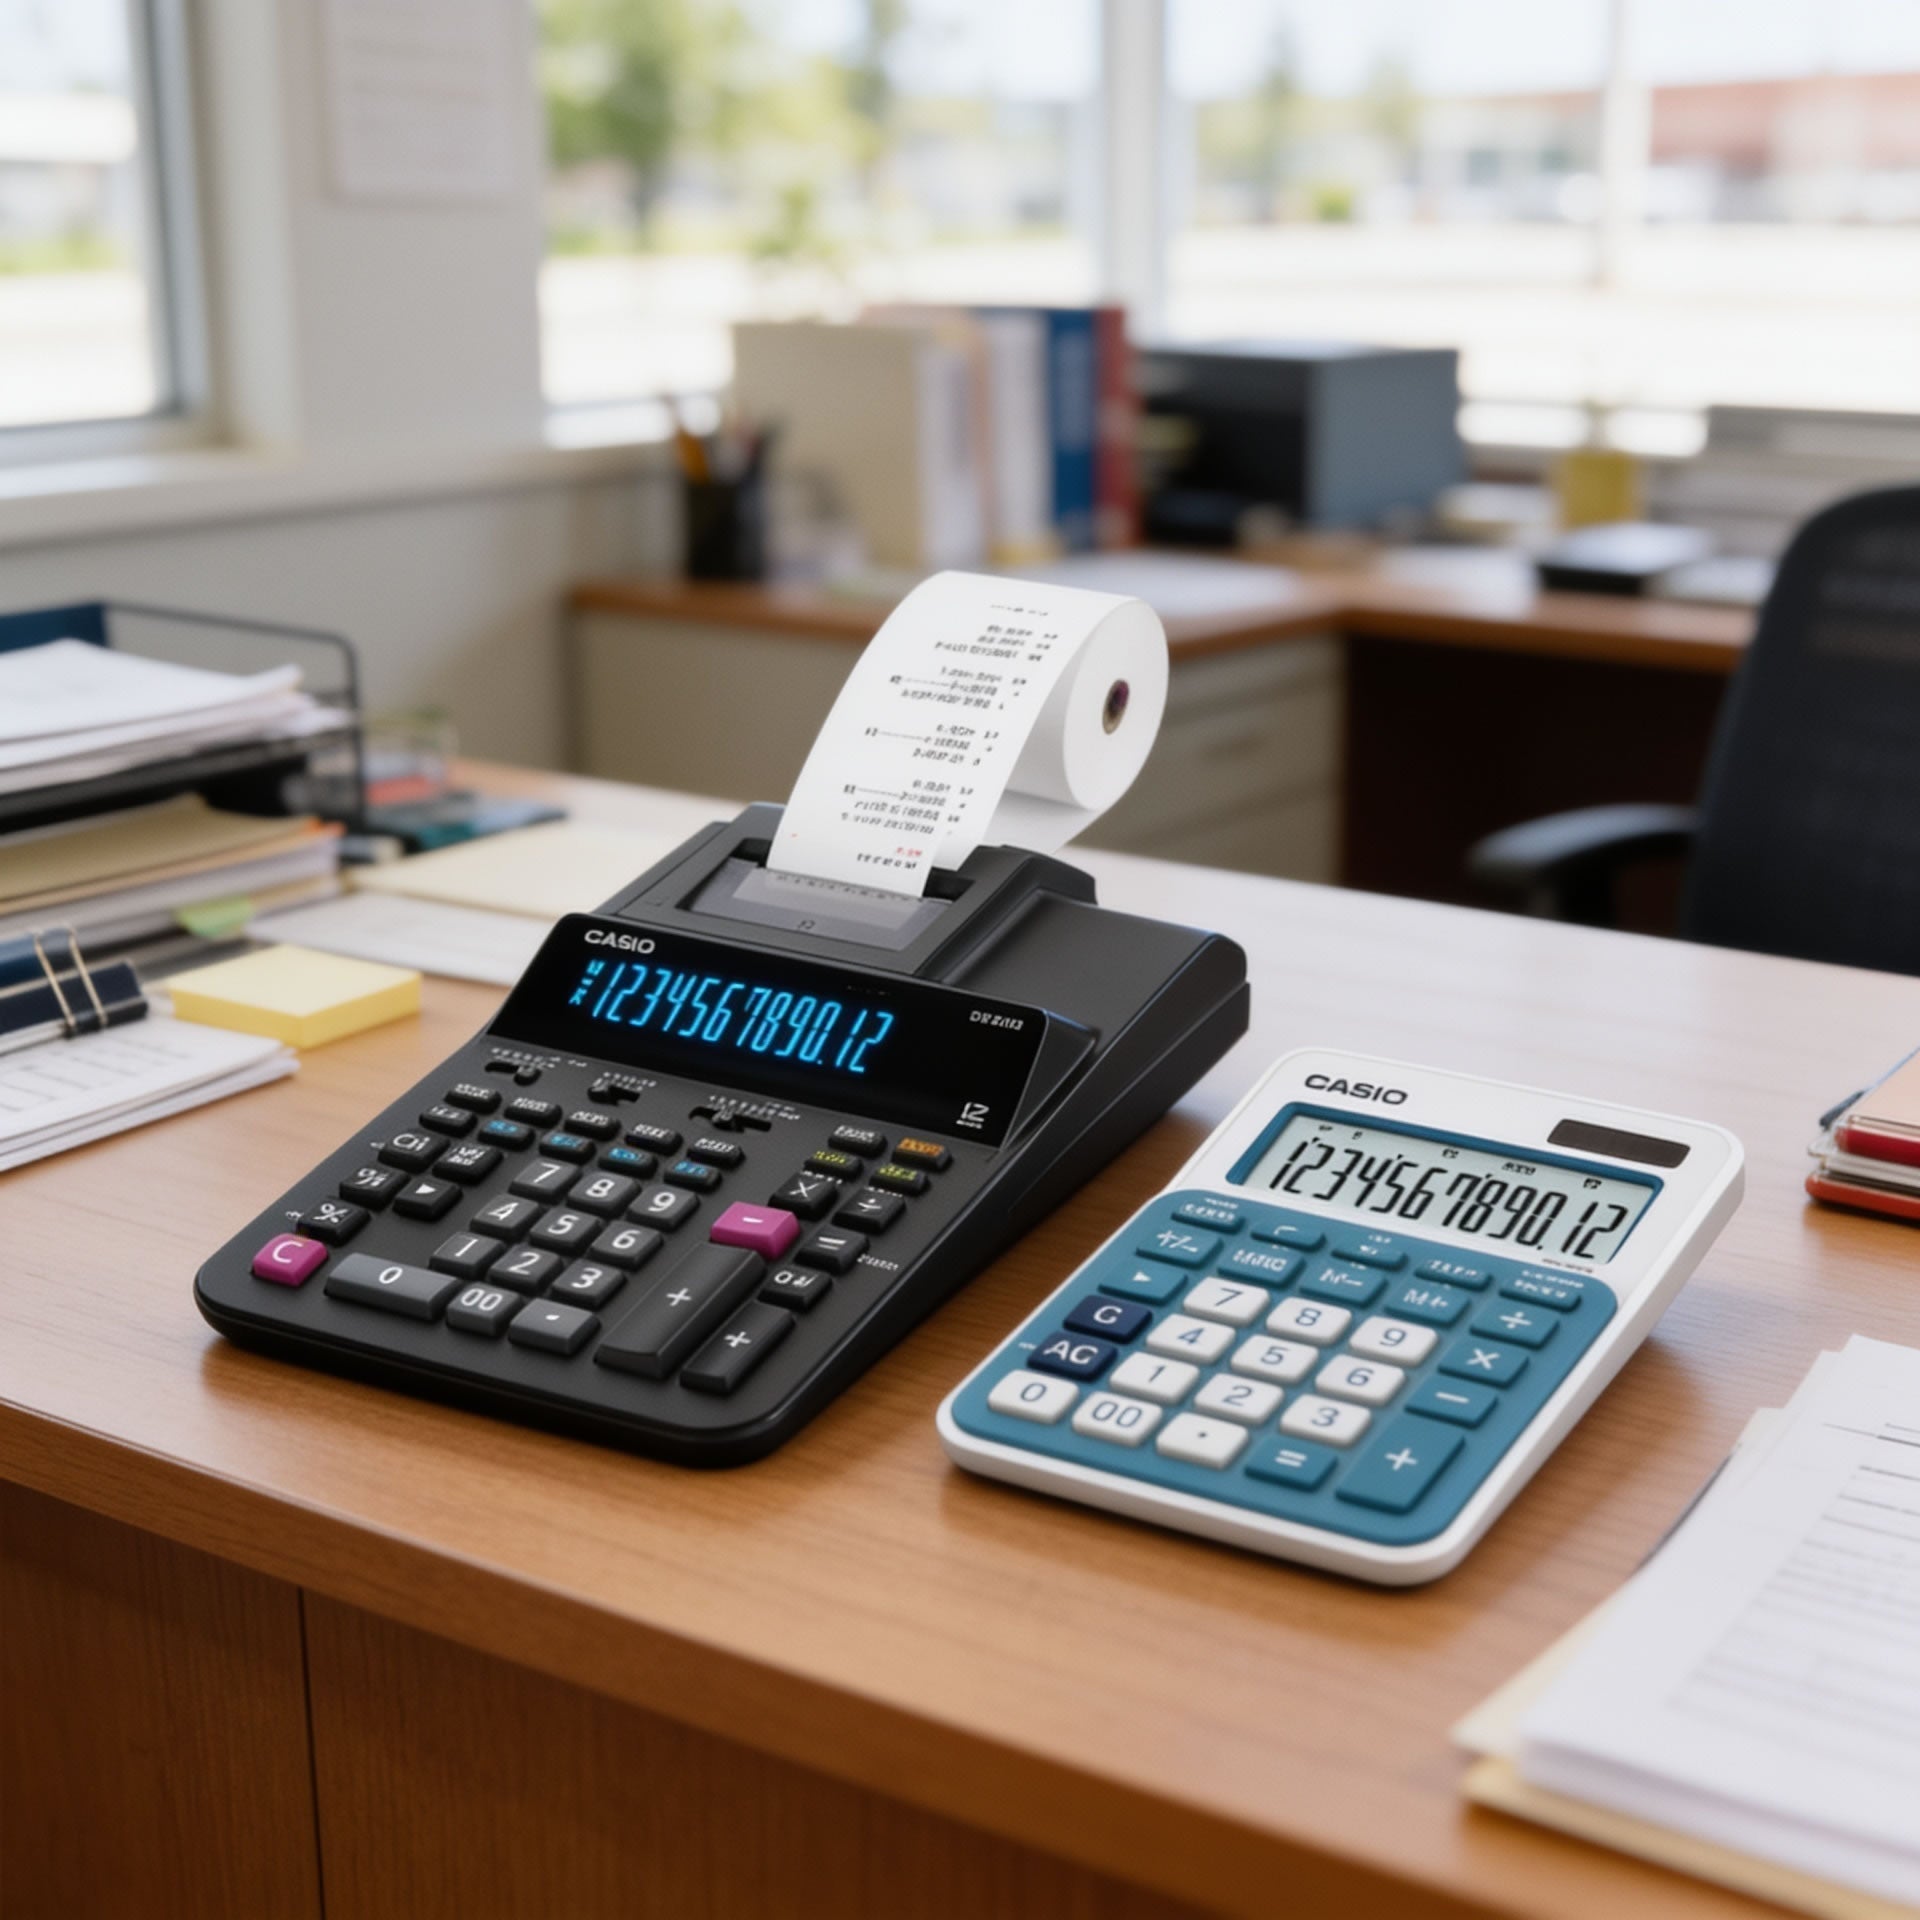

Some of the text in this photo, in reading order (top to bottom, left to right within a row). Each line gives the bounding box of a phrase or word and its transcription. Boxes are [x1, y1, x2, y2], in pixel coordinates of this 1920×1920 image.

[584, 929, 655, 954] CASIO
[1304, 1074, 1408, 1105] CASIO
[533, 1163, 561, 1184] 7
[585, 1178, 616, 1198] 8
[648, 1191, 677, 1211] 9
[489, 1202, 520, 1221] 4
[548, 1215, 580, 1235] 5
[455, 1238, 478, 1257] 1
[612, 1229, 641, 1250] 6
[272, 1240, 304, 1264] C
[508, 1251, 540, 1275] 2
[378, 1266, 403, 1285] 0
[571, 1267, 602, 1289] 3
[461, 1287, 504, 1312] 00
[1212, 1287, 1243, 1307] 7
[1294, 1308, 1322, 1327] 8
[1177, 1327, 1205, 1345] 4
[1379, 1328, 1406, 1348] 9
[1043, 1339, 1099, 1364] AC
[1260, 1346, 1289, 1366] 5
[1147, 1365, 1166, 1383] 1
[1346, 1367, 1375, 1387] 6
[1020, 1382, 1047, 1402] 0
[1221, 1385, 1253, 1407] 2
[1091, 1400, 1143, 1428] 00
[1310, 1407, 1340, 1428] 3
